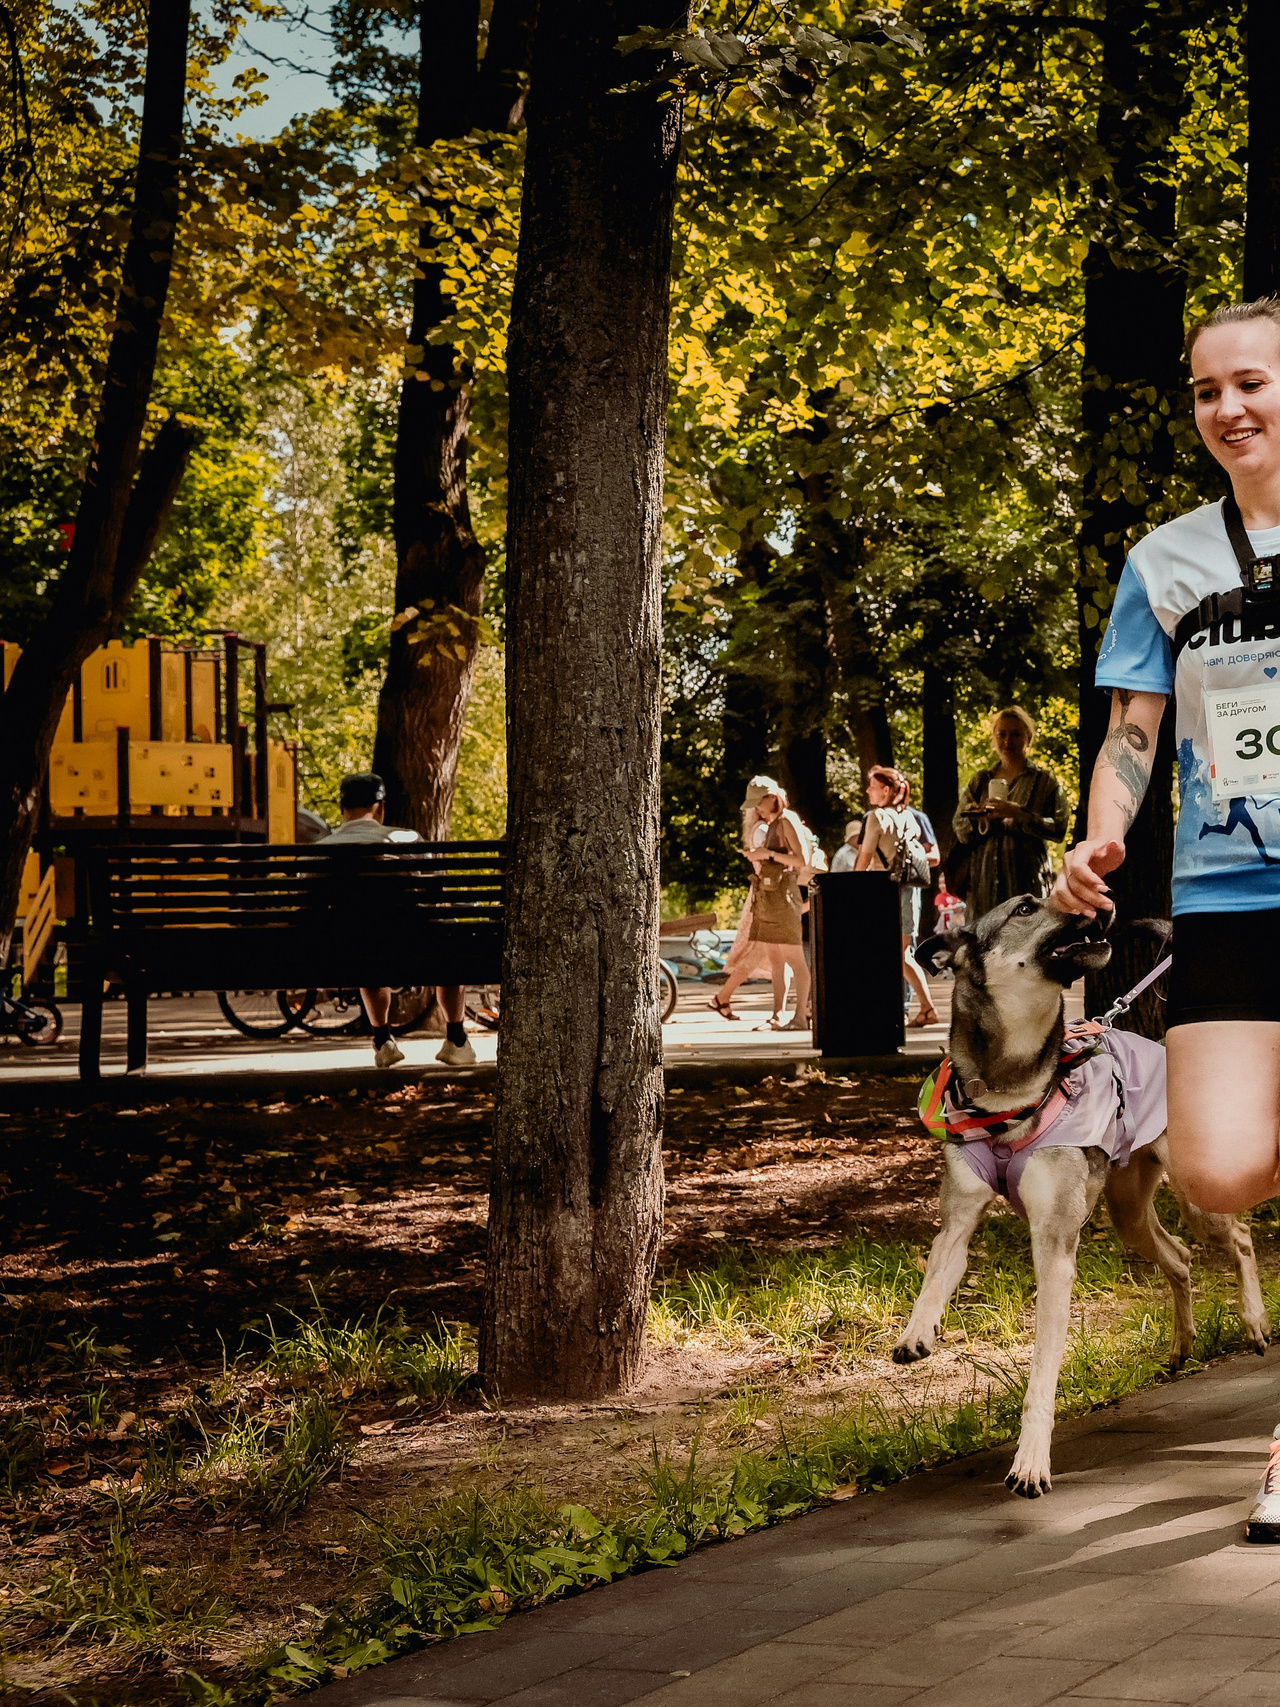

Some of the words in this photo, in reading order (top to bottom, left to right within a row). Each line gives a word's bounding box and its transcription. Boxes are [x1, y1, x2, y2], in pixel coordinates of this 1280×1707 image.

[1215, 701, 1238, 710] БЕГИ
[1216, 710, 1229, 718] ЗА
[1230, 704, 1267, 717] ДРУГОМ
